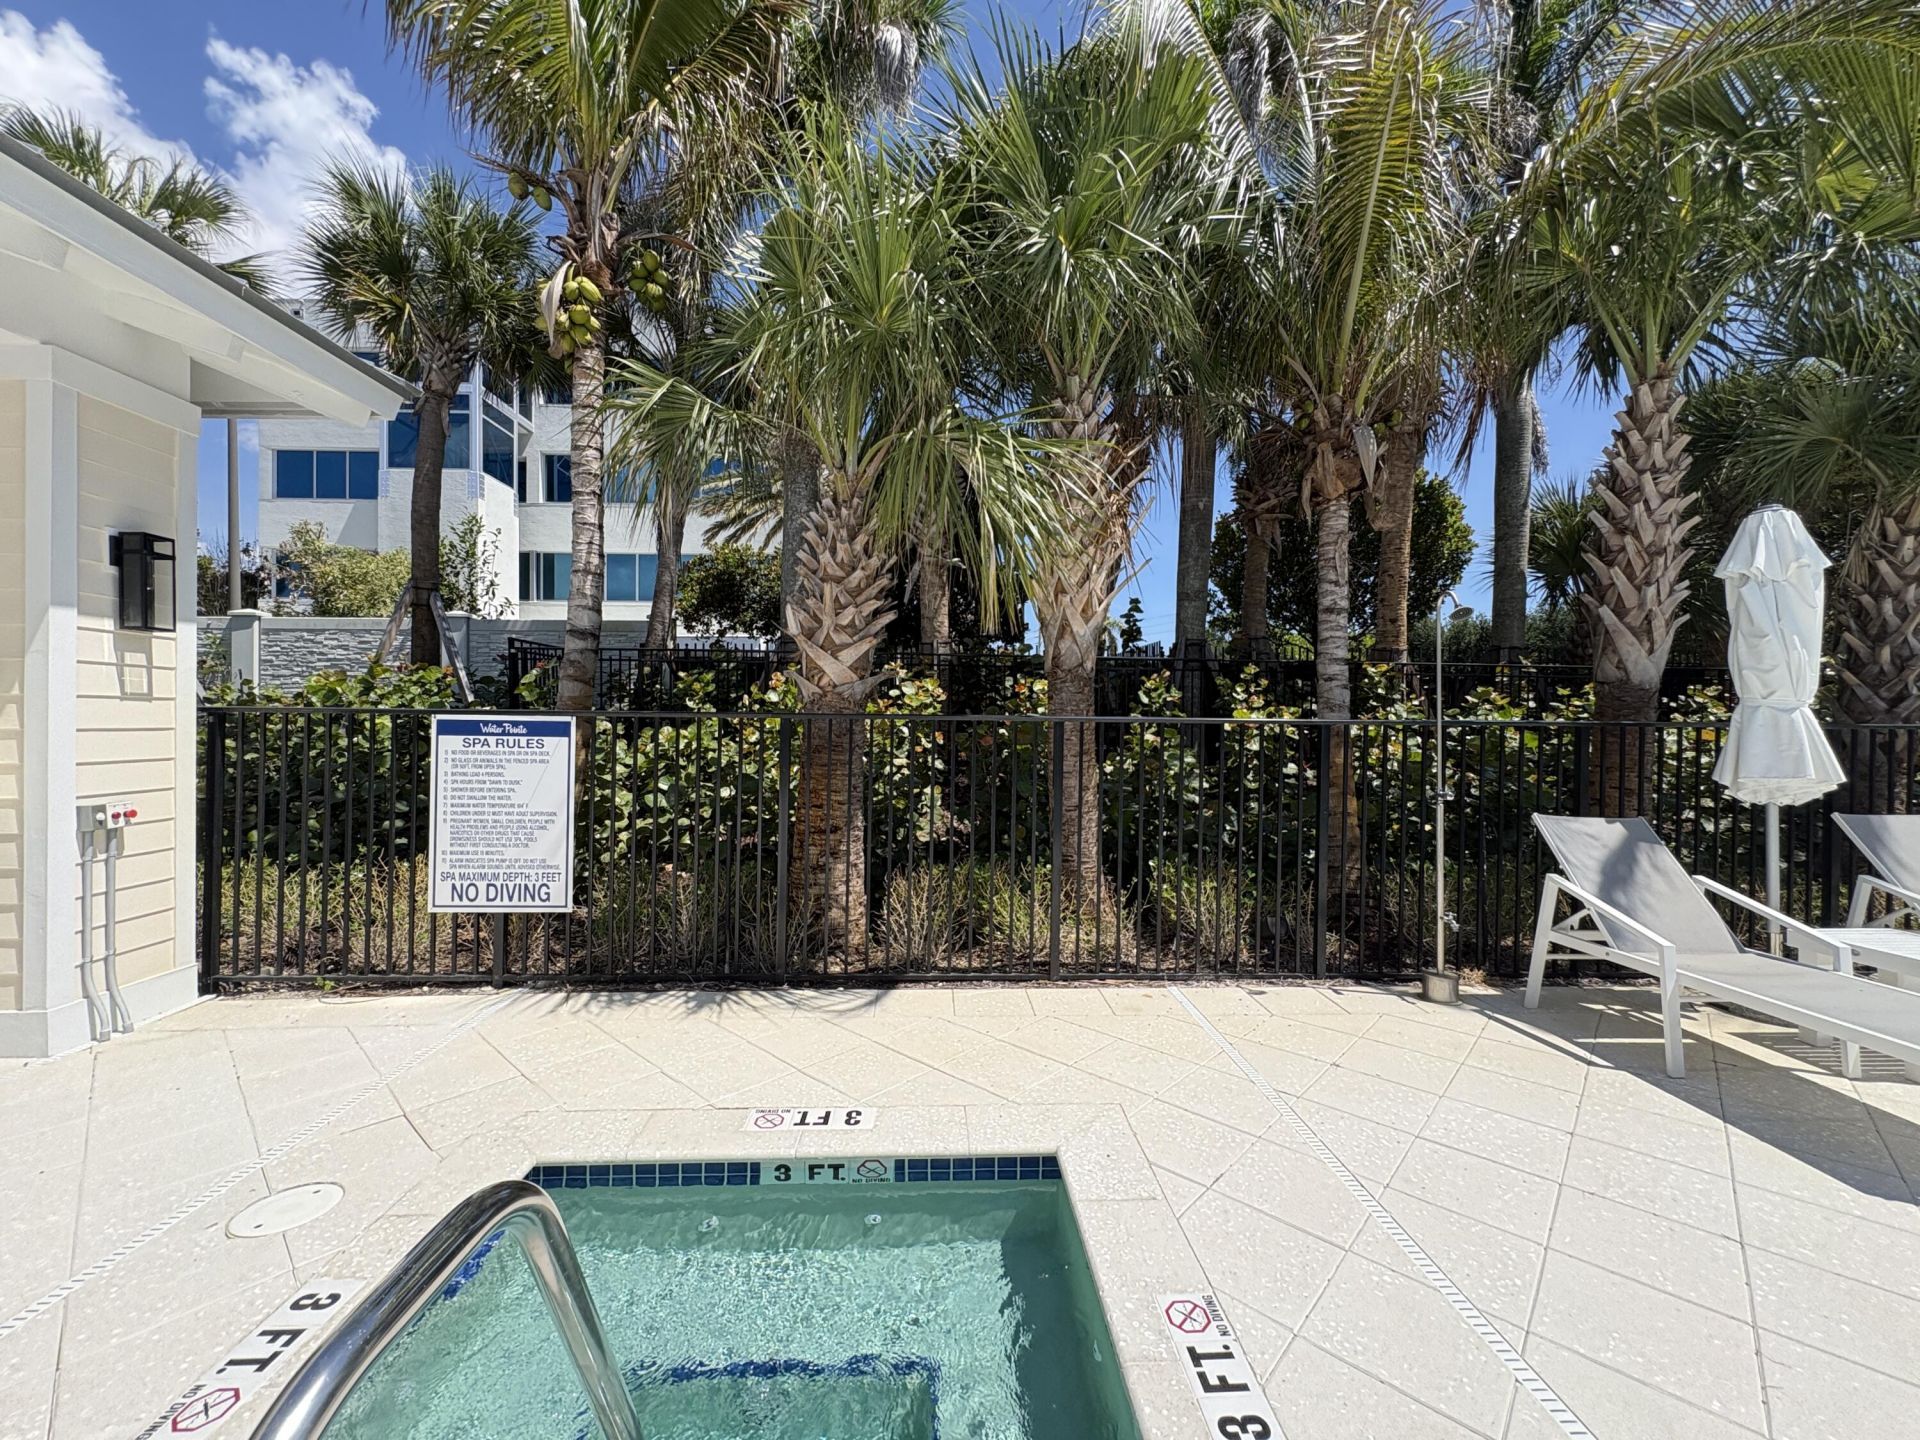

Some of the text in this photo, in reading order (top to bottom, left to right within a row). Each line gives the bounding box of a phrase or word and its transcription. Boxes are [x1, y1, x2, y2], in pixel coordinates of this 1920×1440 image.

[480, 723, 528, 734] Water Pointe
[462, 738, 544, 749] SPA RULES
[440, 872, 562, 882] SPA MAXIMUM DEPTH: 3 FEET
[451, 883, 551, 902] NO DIVING
[794, 1110, 862, 1126] 3 FT.
[774, 1164, 846, 1182] 3 FT.
[1202, 1295, 1231, 1336] NO DIVING
[216, 1293, 341, 1374] 3 FT.
[1186, 1344, 1271, 1440] 3 FT.
[135, 1384, 207, 1440] NO DIVING
